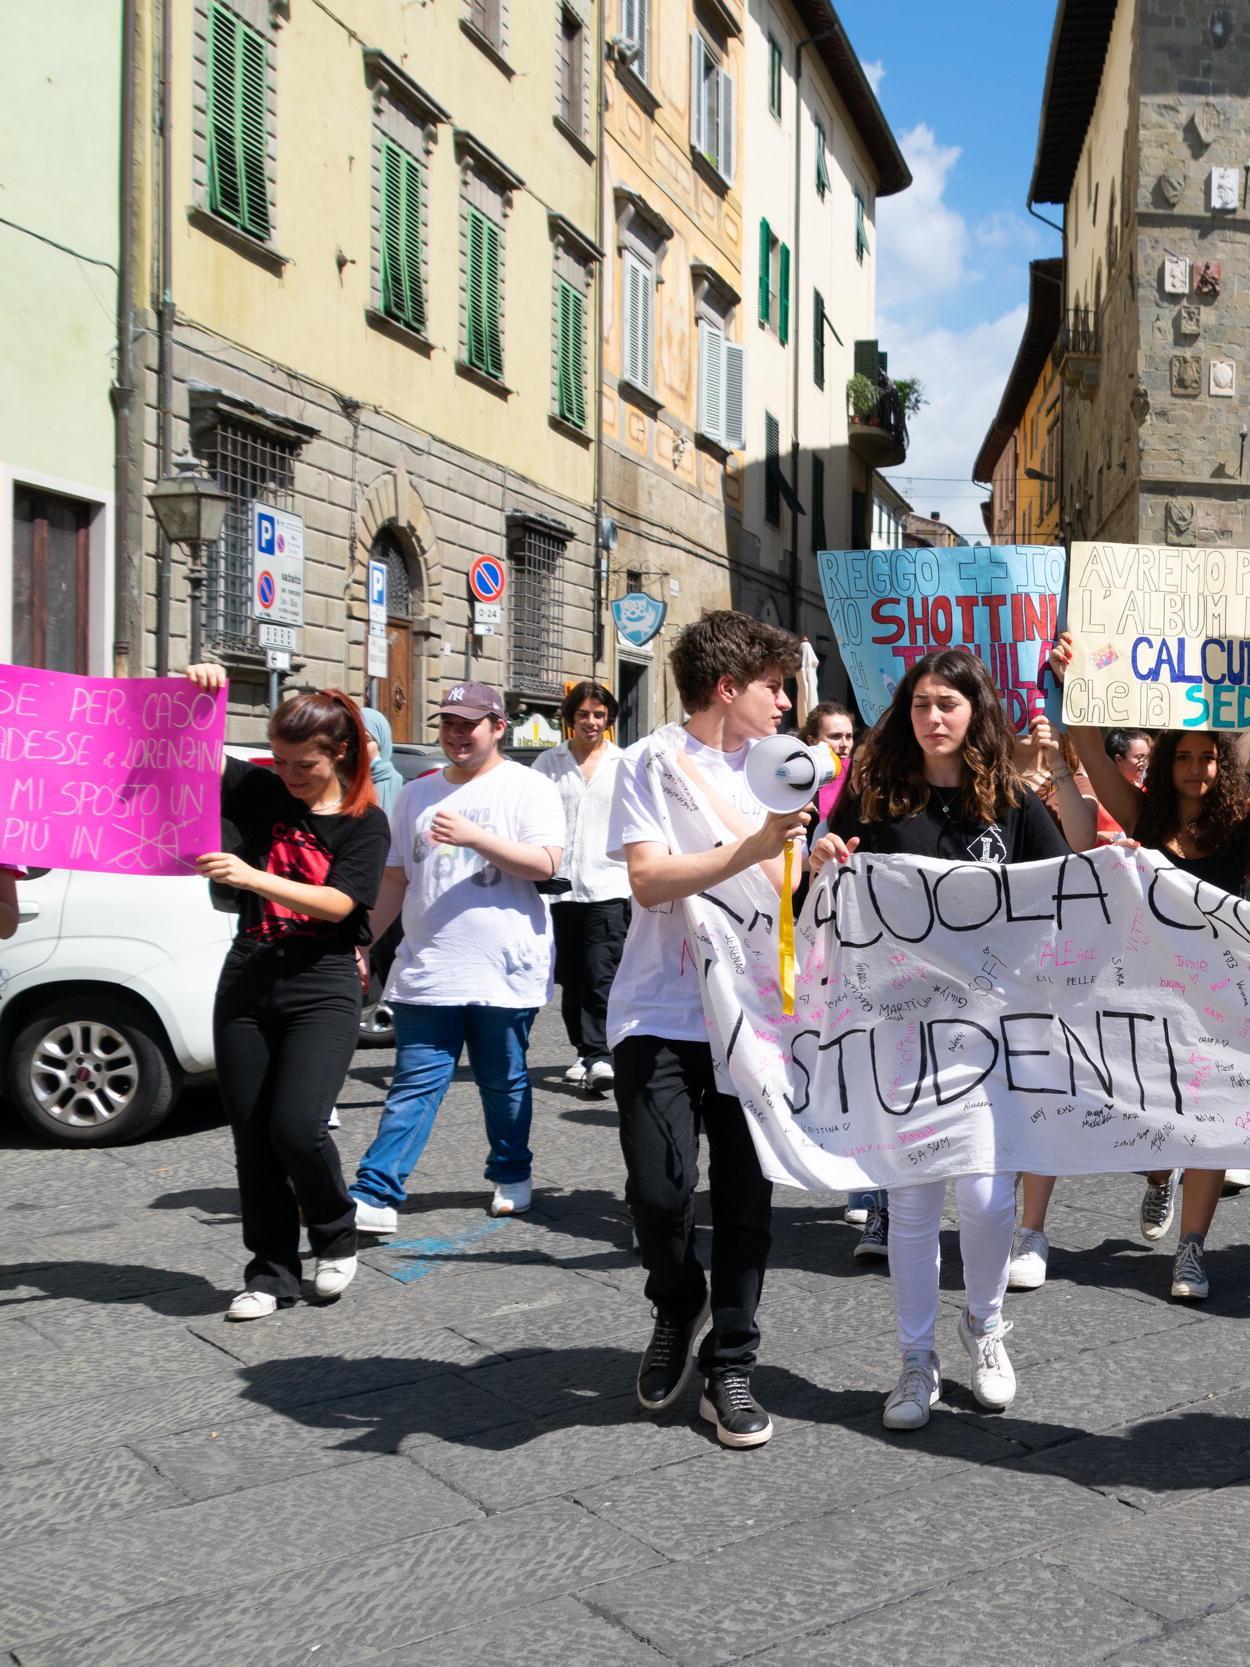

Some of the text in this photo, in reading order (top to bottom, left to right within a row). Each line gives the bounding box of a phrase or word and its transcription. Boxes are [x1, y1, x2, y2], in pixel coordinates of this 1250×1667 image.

[818, 549, 940, 600] REGGO
[1016, 546, 1065, 595] IO
[1079, 546, 1226, 595] AVREMO
[871, 595, 1058, 645] SHOTTINI
[1081, 590, 1227, 637] L'ALBUM
[69, 687, 126, 727] PER
[142, 691, 217, 731] CASO
[1066, 677, 1129, 725] Che
[1147, 682, 1171, 727] la
[10, 776, 45, 812] MI
[170, 783, 204, 817] UN
[70, 825, 104, 860] IN
[783, 1010, 1185, 1116] STUDENTI
